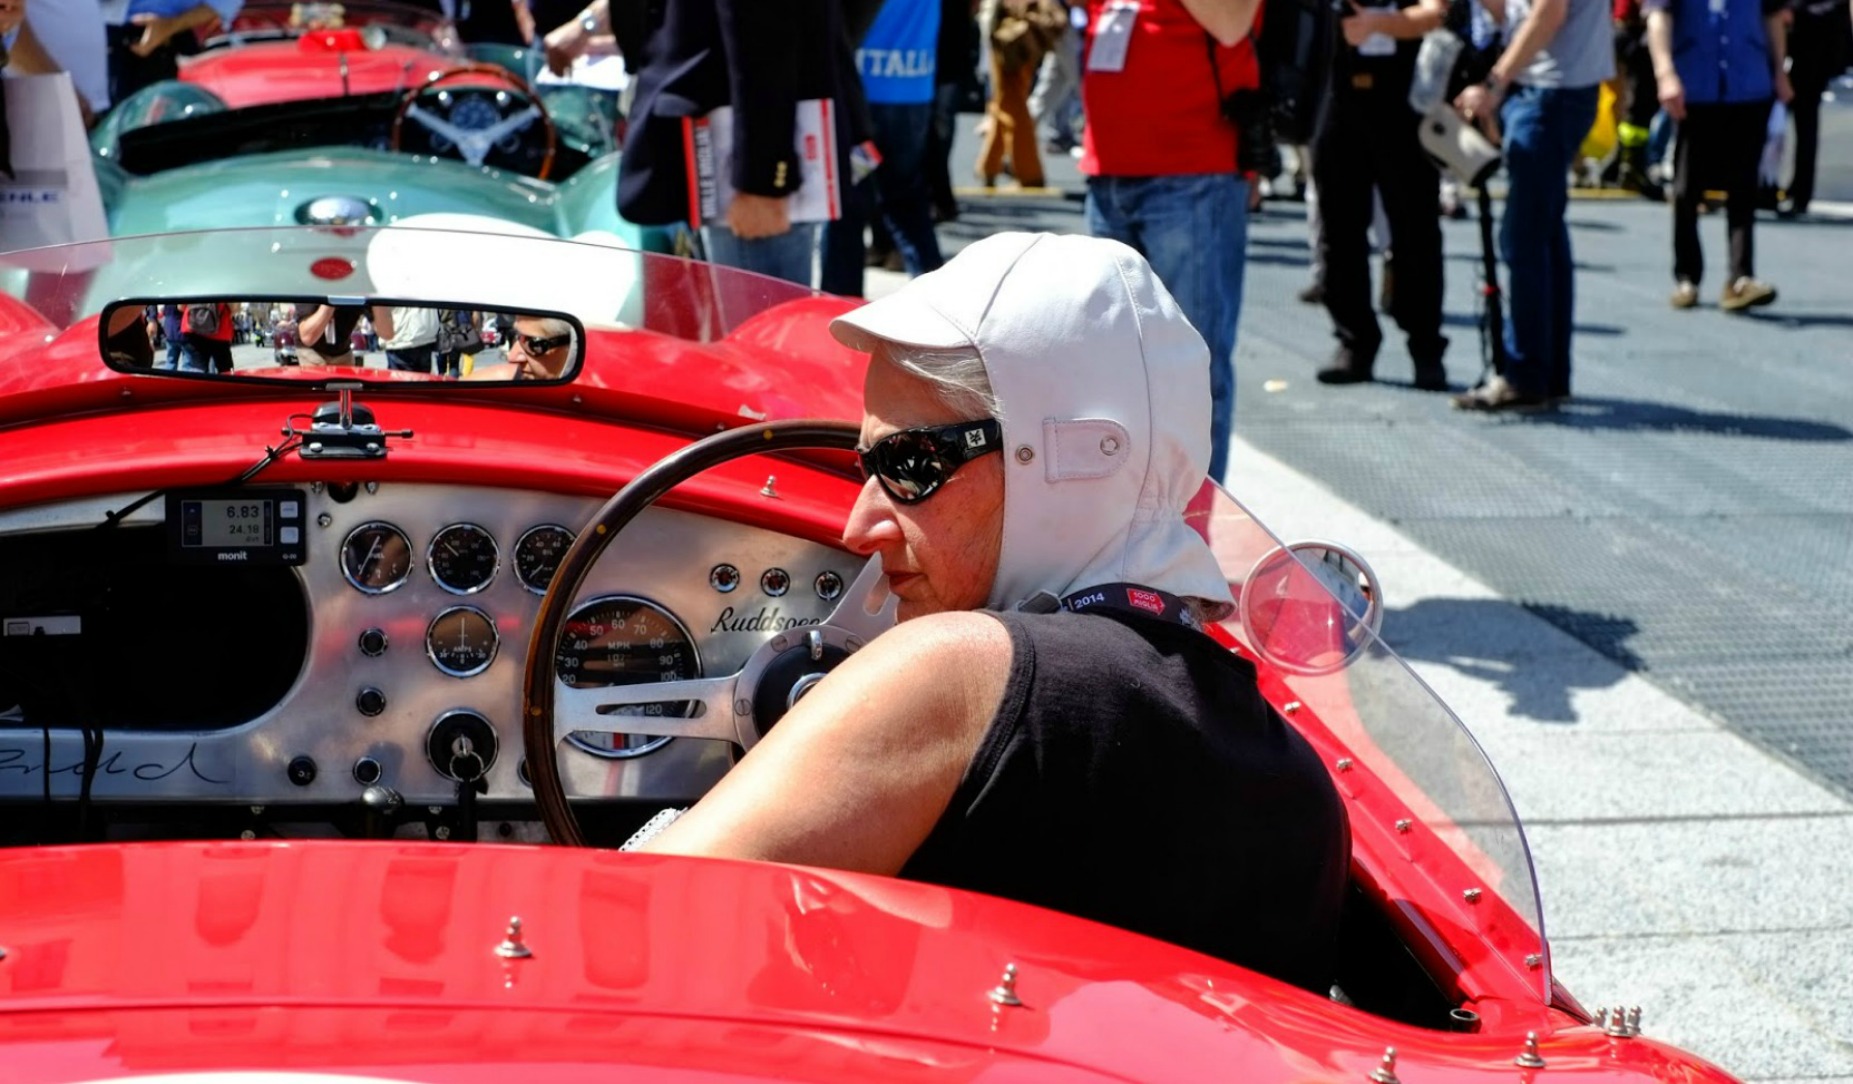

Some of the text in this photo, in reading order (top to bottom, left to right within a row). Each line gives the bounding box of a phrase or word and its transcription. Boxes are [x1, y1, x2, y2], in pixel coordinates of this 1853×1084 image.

[227, 505, 259, 519] 6.83
[217, 550, 247, 560] monit
[1074, 592, 1105, 609] 2014
[611, 619, 625, 630] 60
[633, 624, 647, 636] 70
[589, 625, 604, 636] 50
[573, 640, 588, 650] 40
[607, 642, 631, 650] MPH
[649, 639, 664, 649] 80
[564, 656, 579, 668] 30
[659, 655, 674, 666] 90
[562, 674, 577, 685] 20
[660, 671, 678, 682] 100
[645, 703, 663, 715] 120
